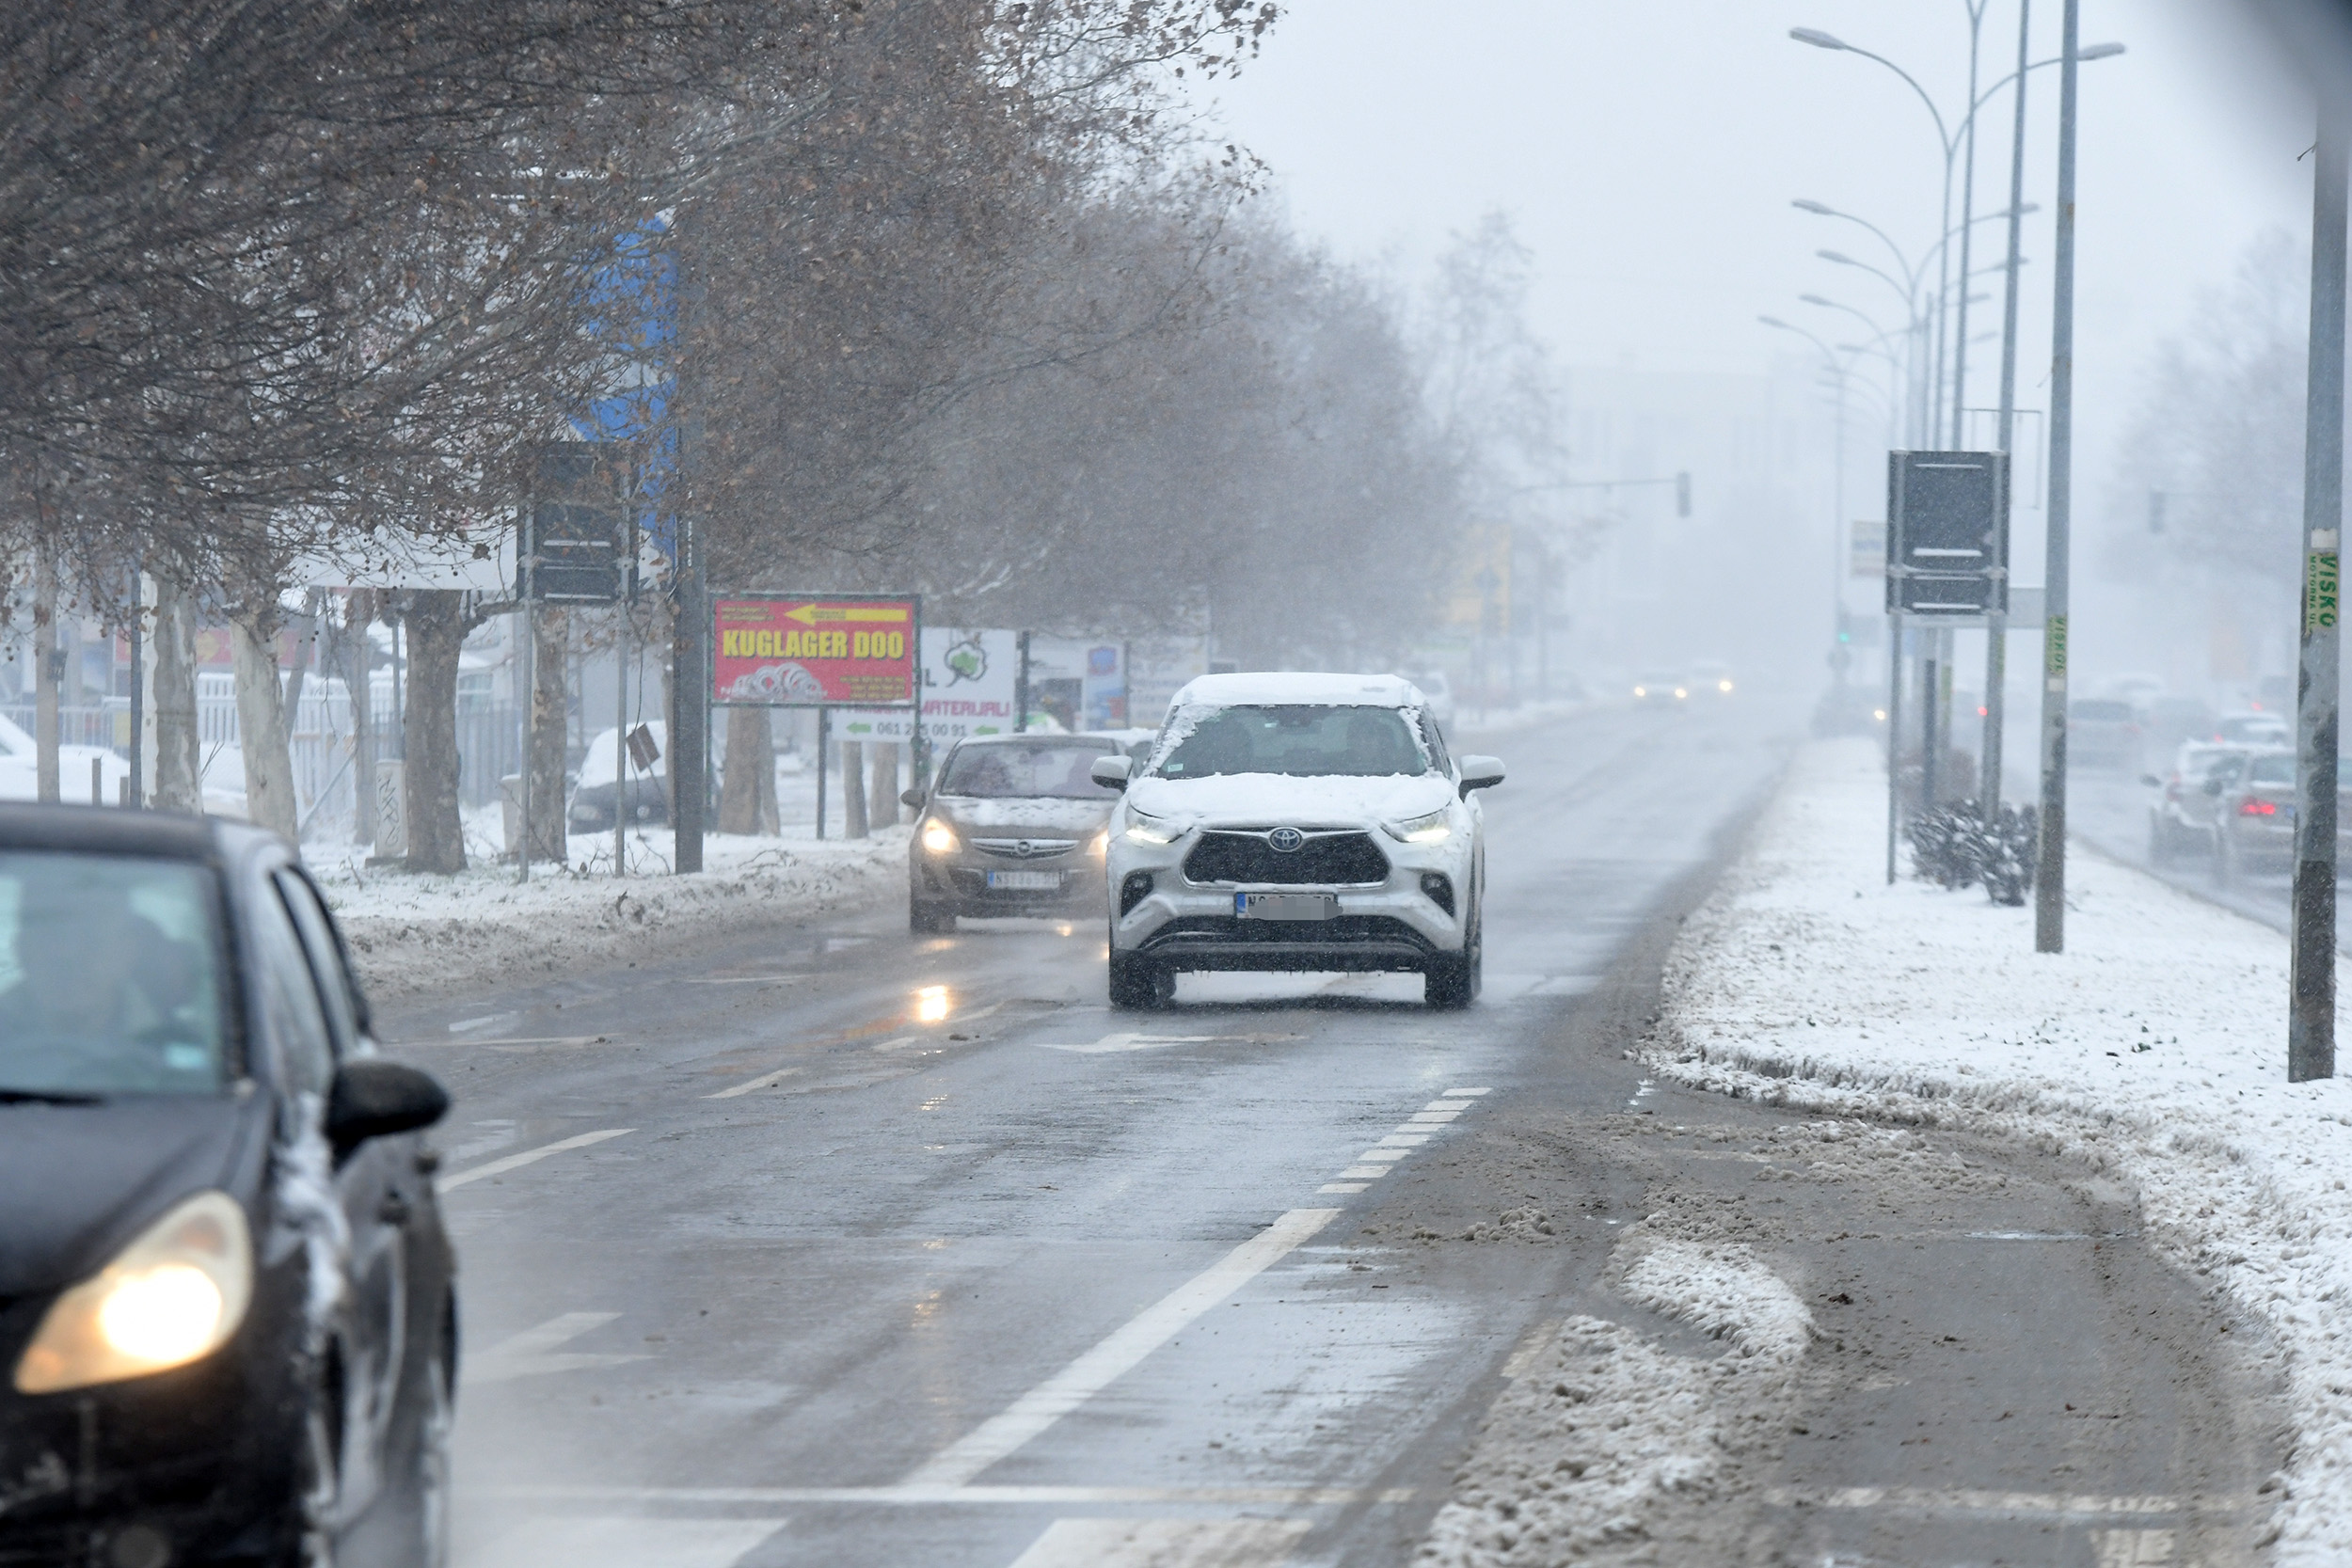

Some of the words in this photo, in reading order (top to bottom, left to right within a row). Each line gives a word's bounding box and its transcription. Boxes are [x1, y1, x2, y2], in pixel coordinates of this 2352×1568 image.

[723, 629, 848, 659] KUGLAGER
[853, 630, 905, 659] DOO
[877, 721, 900, 736] 061
[931, 722, 949, 736] 00
[951, 723, 967, 737] 91
